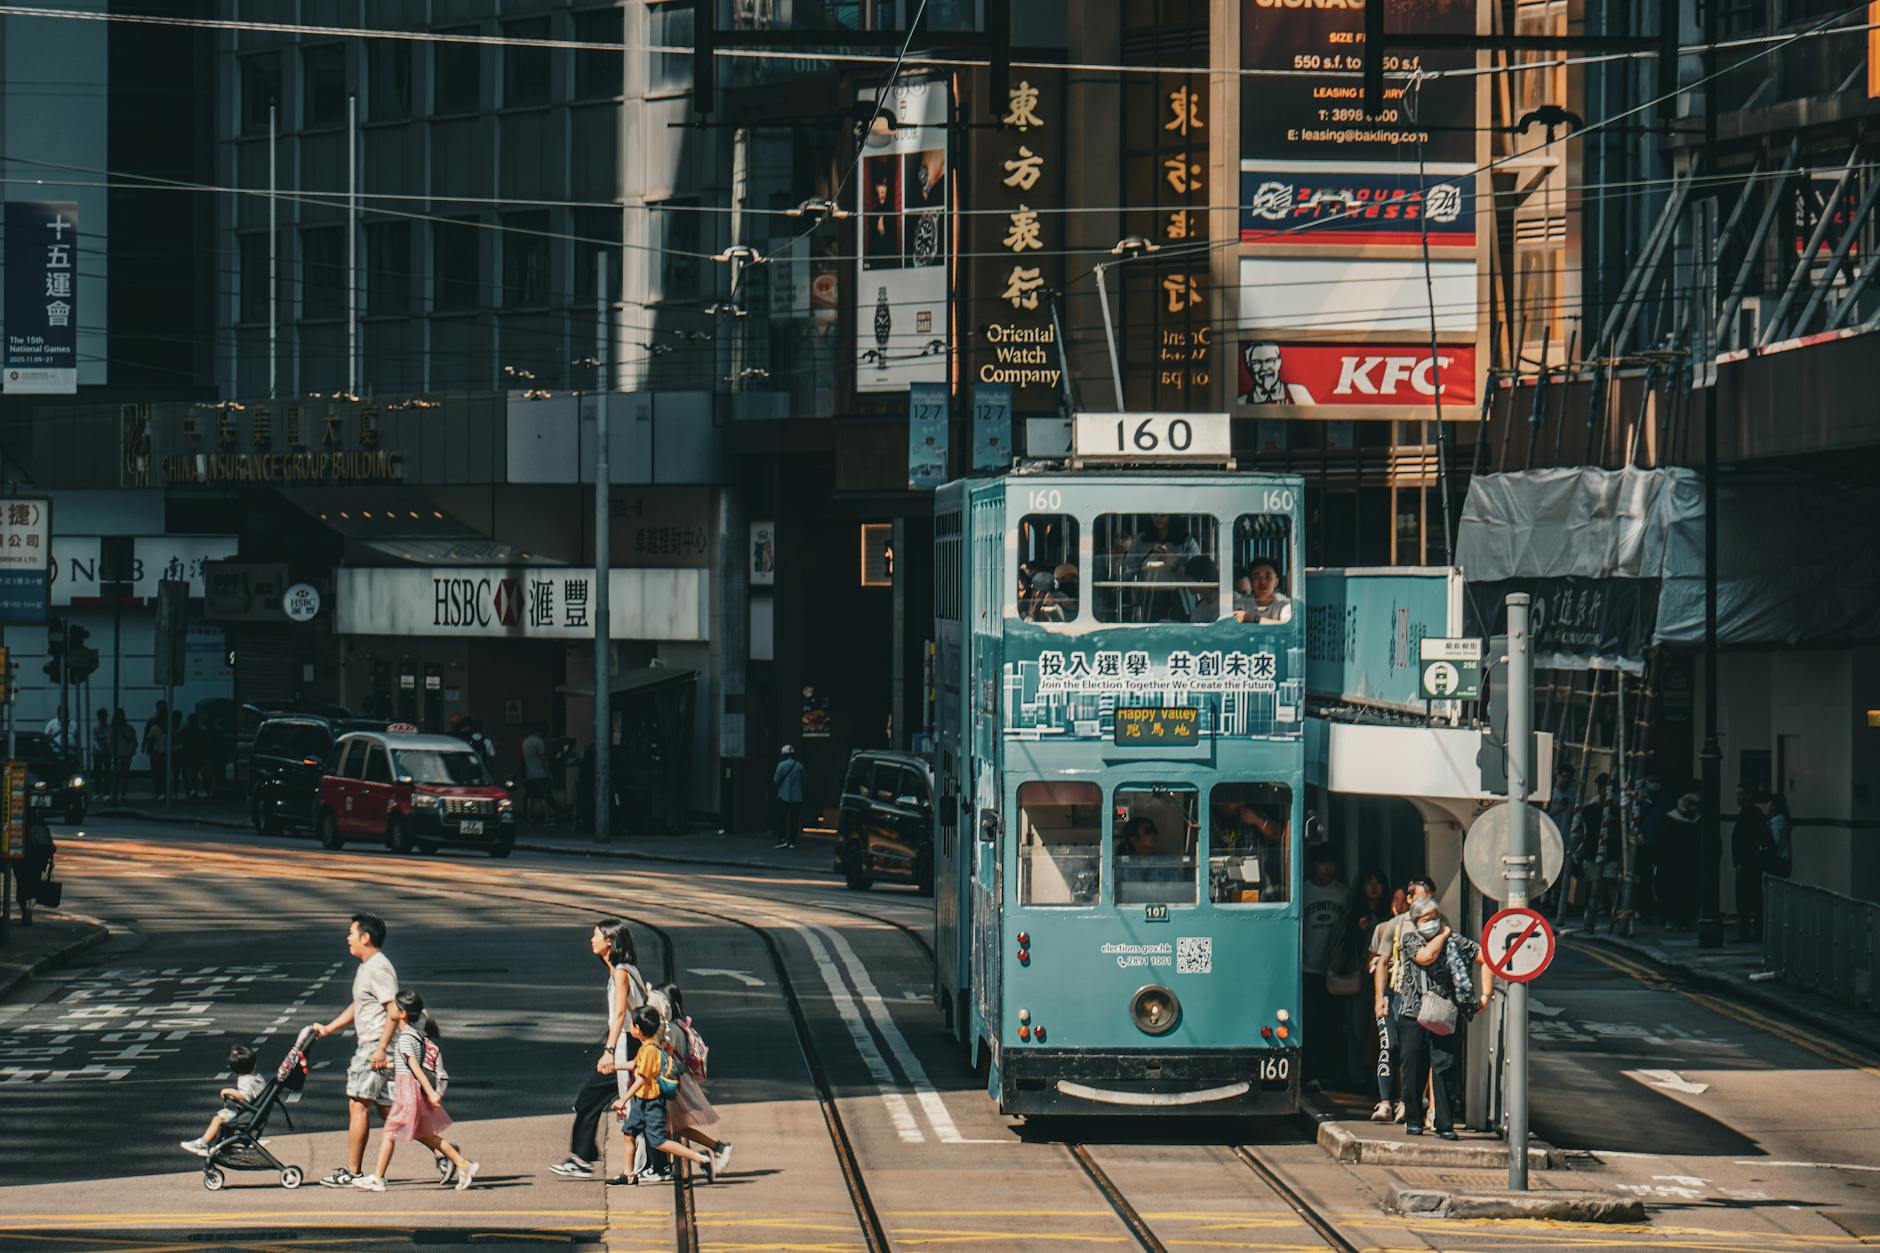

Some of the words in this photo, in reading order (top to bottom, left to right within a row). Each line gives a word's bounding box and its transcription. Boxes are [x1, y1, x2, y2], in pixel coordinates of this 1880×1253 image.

[1328, 32, 1354, 44] SIZE
[1294, 55, 1321, 69] 550
[1323, 55, 1342, 69] s.f.
[1346, 55, 1362, 69] to
[1313, 87, 1358, 98] LEASING
[1318, 109, 1329, 121] T:
[1332, 109, 1364, 122] 3898
[1287, 129, 1299, 141] E:
[1001, 80, 1045, 311] 東方表行
[46, 213, 72, 327] 十五運會
[10, 336, 25, 345] The
[27, 336, 44, 345] 15th
[986, 323, 1055, 344] Oriental
[10, 345, 43, 353] National
[44, 345, 71, 353] Games
[996, 345, 1048, 365] Watch
[979, 364, 1062, 389] Company
[1332, 356, 1451, 395] KFC
[1116, 418, 1193, 452] 160
[160, 454, 199, 481] CHINA
[204, 452, 278, 481] INSURANCE
[283, 451, 328, 481] GROUP
[332, 449, 399, 481] BUILDING
[1028, 489, 1062, 511] 160
[1262, 489, 1294, 511] 160
[290, 598, 316, 608] HSBC
[433, 577, 491, 628] HSBC
[1040, 652, 1149, 677] 投入選舉
[1169, 652, 1275, 678] 共創未來
[1041, 681, 1061, 690] Join
[1063, 681, 1080, 689] the
[1082, 680, 1123, 690] Election
[1125, 680, 1170, 691] Together
[1172, 681, 1188, 689] We
[1190, 680, 1223, 690] Create
[1225, 681, 1241, 689] the
[1243, 681, 1274, 690] Future
[1118, 708, 1156, 722] Happy
[1161, 708, 1197, 722] Valley
[1124, 723, 1190, 738] 跑馬地
[1146, 906, 1166, 917] 107
[1101, 943, 1172, 954] elections.gov.hk
[1127, 957, 1149, 966] 2891
[1151, 957, 1172, 966] 1001
[10, 1018, 216, 1034] BUS
[1259, 1057, 1290, 1081] 160
